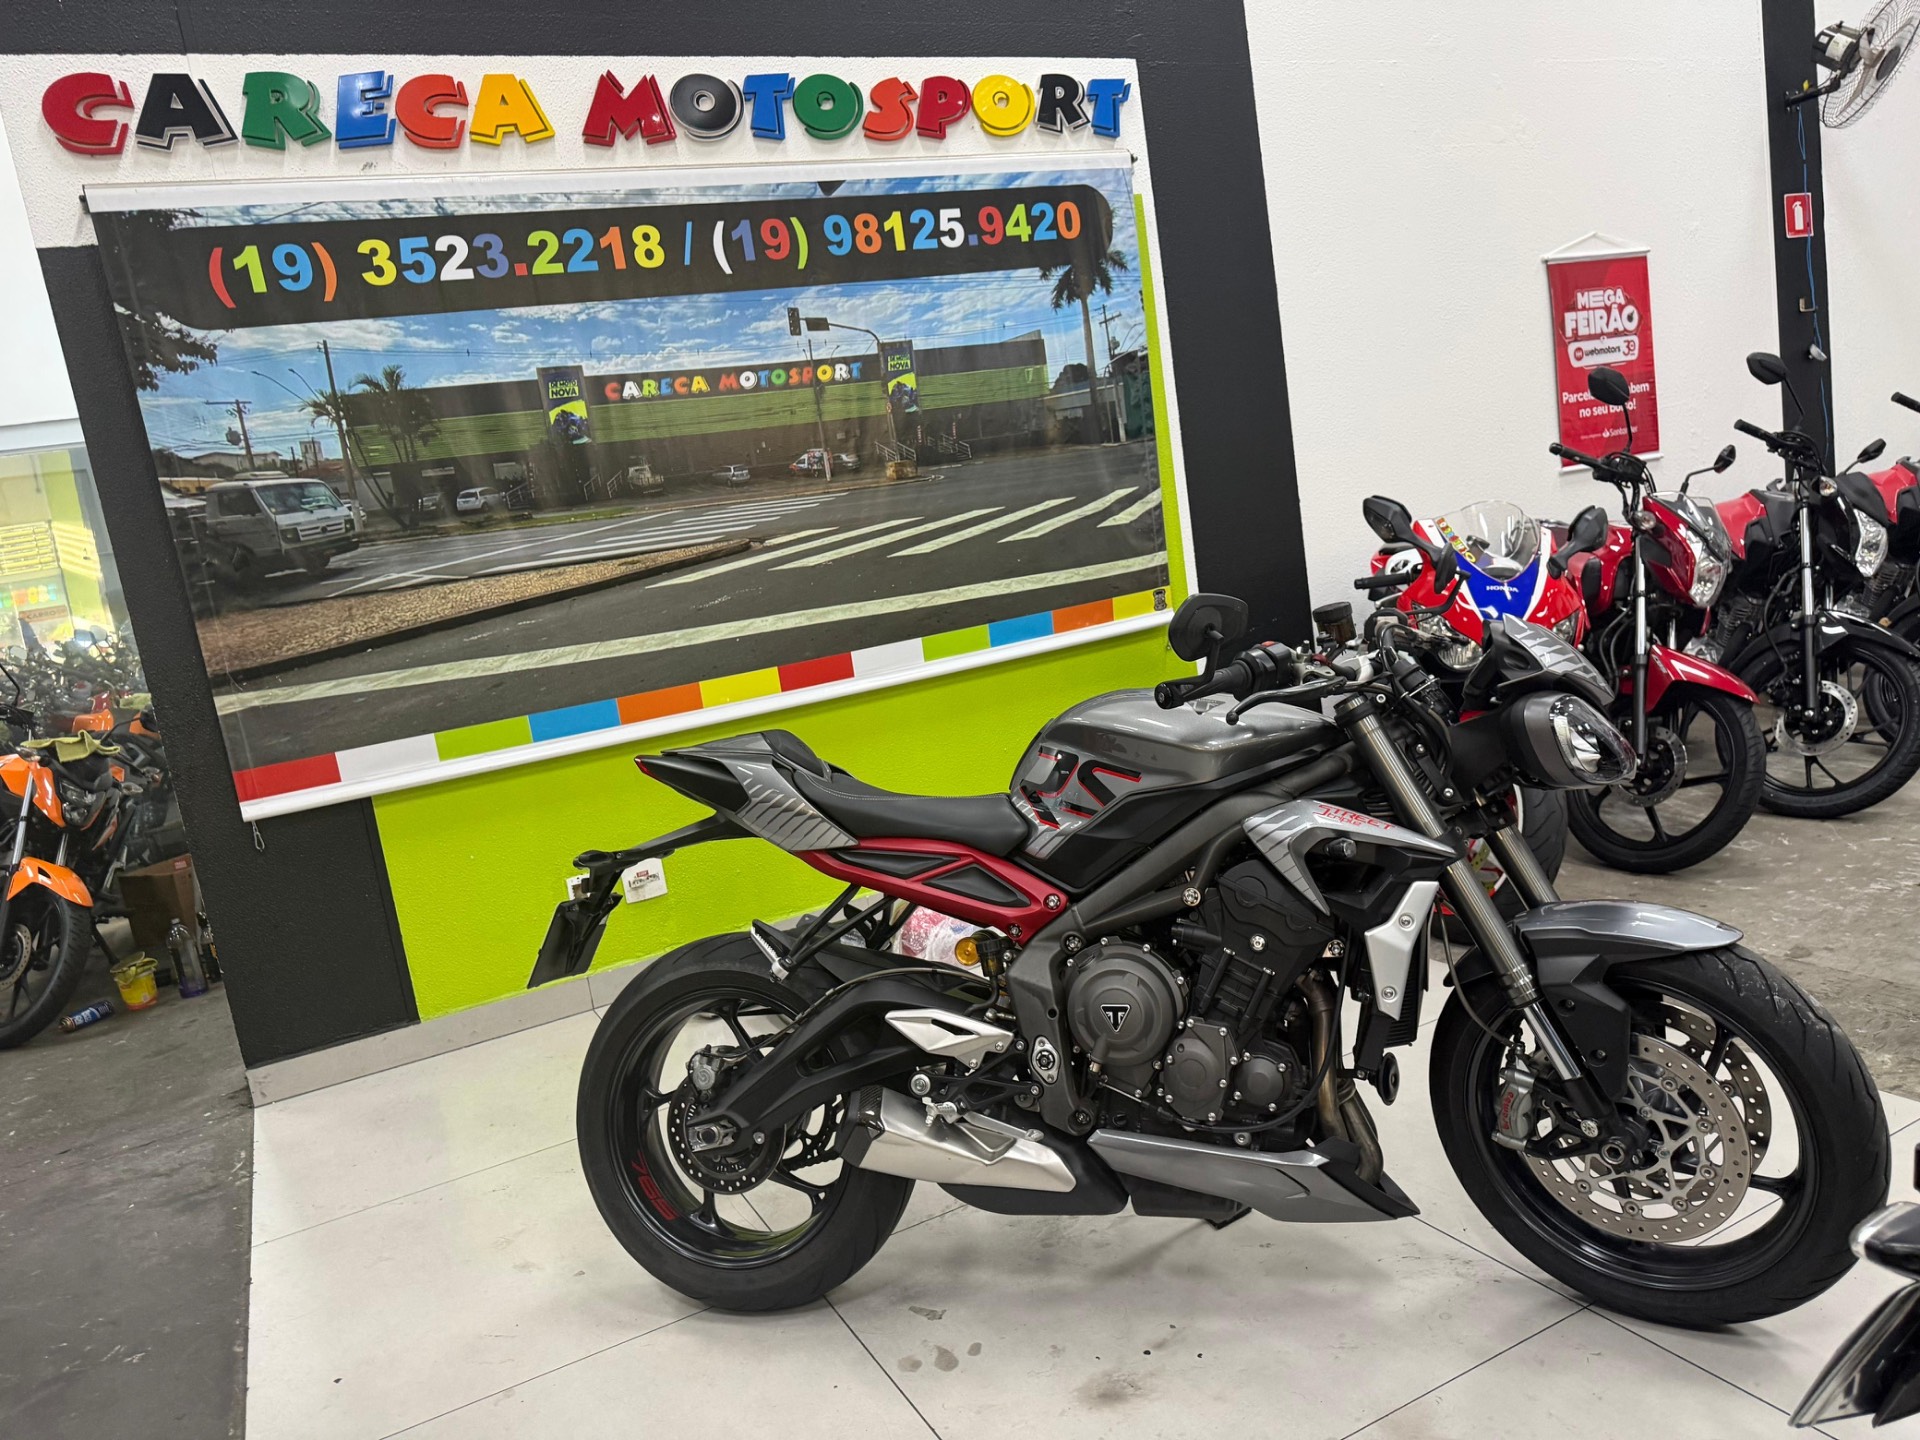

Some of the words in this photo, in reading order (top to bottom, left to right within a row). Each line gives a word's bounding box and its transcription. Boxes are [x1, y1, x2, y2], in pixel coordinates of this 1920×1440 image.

[41, 70, 555, 155] CARECA
[582, 69, 1130, 146] MOTOSPORT
[208, 242, 337, 308] (19)
[357, 224, 665, 286] 3523.2218
[712, 217, 809, 274] (19)
[824, 201, 1081, 256] 98125.9420
[1577, 288, 1625, 309] MEGA
[1564, 304, 1639, 337] FEIRÃO
[1585, 345, 1620, 356] webmotors
[552, 387, 577, 398] NOVA
[605, 376, 710, 400] CARECA
[719, 362, 862, 391] MOTOSPORT
[1579, 408, 1591, 418] no
[1593, 405, 1608, 416] seu
[1312, 804, 1395, 830] STREET
